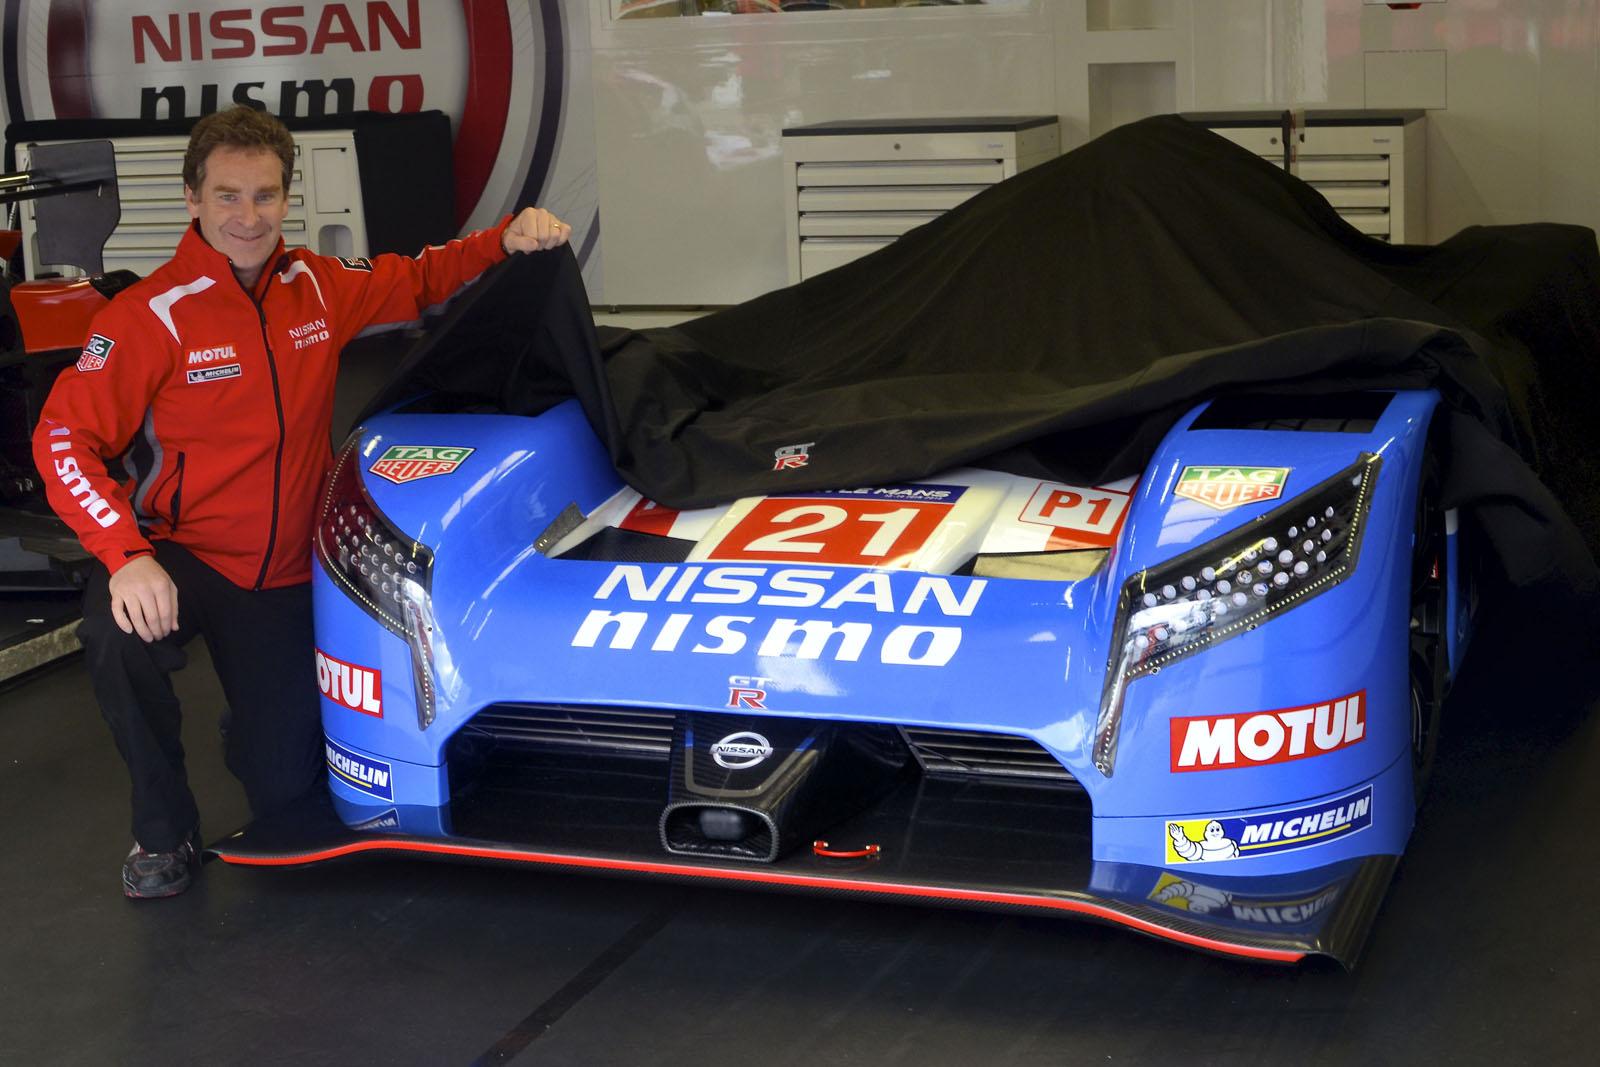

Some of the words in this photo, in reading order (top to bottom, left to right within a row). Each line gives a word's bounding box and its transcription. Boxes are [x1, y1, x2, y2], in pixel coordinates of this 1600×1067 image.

[132, 0, 421, 64] NISSAN
[188, 346, 236, 364] MOTUL
[395, 448, 463, 460] TAG
[774, 442, 816, 458] GT
[376, 461, 453, 480] HEUER
[772, 453, 809, 471] R
[1193, 468, 1277, 481] TAG
[873, 488, 952, 498] MANS
[1181, 482, 1279, 504] HEUER
[1038, 489, 1113, 526] P1
[743, 504, 921, 557] 21
[593, 564, 988, 617] NISSAN
[571, 609, 963, 667] nismo
[316, 651, 380, 714] OTUL
[728, 675, 774, 689] GT
[725, 686, 769, 710] R
[1177, 695, 1365, 767] MOTUL
[716, 745, 767, 755] NISSAN
[1240, 796, 1370, 844] MICHELIN
